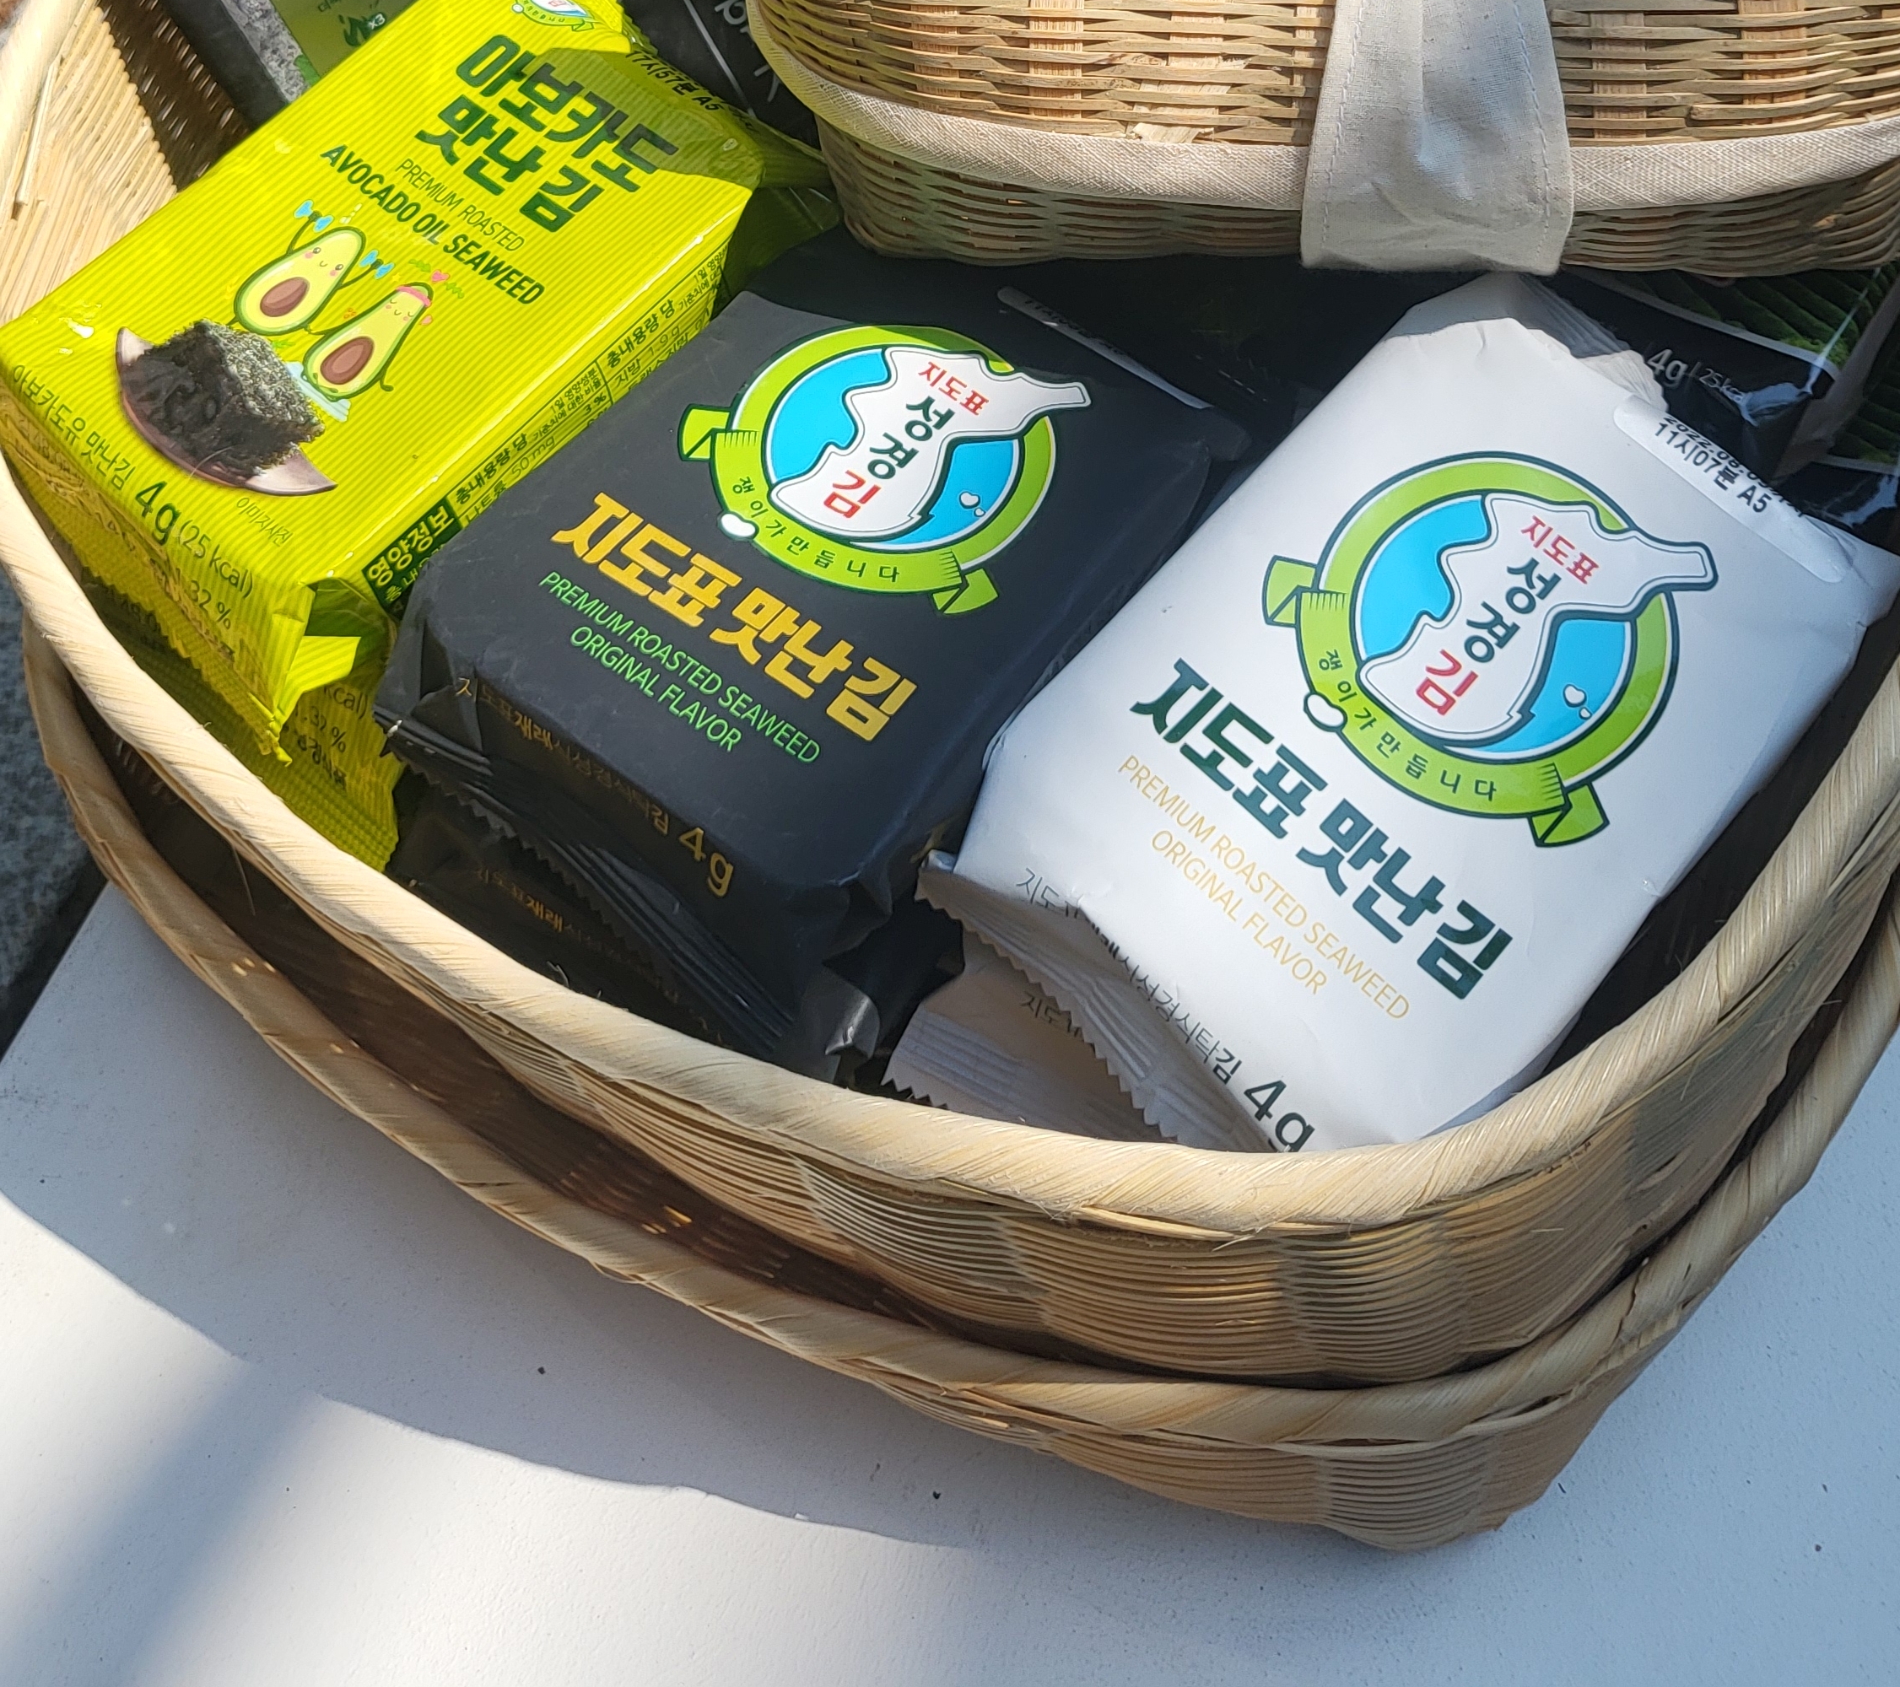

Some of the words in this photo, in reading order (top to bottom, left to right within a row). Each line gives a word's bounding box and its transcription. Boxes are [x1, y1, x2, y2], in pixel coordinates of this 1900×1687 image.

[455, 34, 679, 194] 아보카도
[320, 144, 420, 223] AVOCADO
[413, 213, 442, 246] OIL
[442, 233, 546, 306] SEAWEED
[394, 158, 465, 213] PREMIUM
[459, 204, 526, 253] ROASTED
[606, 313, 660, 369] 총내용량
[659, 298, 676, 319] 당
[615, 358, 642, 387] 지방
[1646, 348, 1689, 390] 4g
[918, 360, 990, 416] 지도표
[12, 364, 87, 446] 아보카도유
[81, 430, 137, 492] 맛난김
[134, 481, 182, 546] 4g
[208, 544, 255, 599] kcal)
[455, 446, 511, 506] 총내용량
[512, 431, 529, 452] 당
[1654, 422, 1740, 491] 11시07분
[1736, 484, 1772, 513] A5
[236, 497, 293, 548] 이미지사진
[367, 505, 455, 587] 영양정보
[550, 491, 743, 628] 지도표
[1520, 514, 1600, 586] 지도표
[538, 570, 636, 637] PREMIUM
[625, 625, 723, 697] ROASTED
[717, 685, 822, 764] SEAWEED
[569, 625, 664, 698] ORIGINAL
[657, 683, 743, 753] FLAVOR
[1129, 657, 1329, 840] 지도표
[678, 826, 735, 897] 4g
[1117, 754, 1218, 845] PREMIUM
[1209, 834, 1309, 930] ROASTED
[1302, 921, 1412, 1021] SEAWEED
[1150, 829, 1248, 922] ORIGINAL
[1241, 910, 1329, 997] FLAVOR
